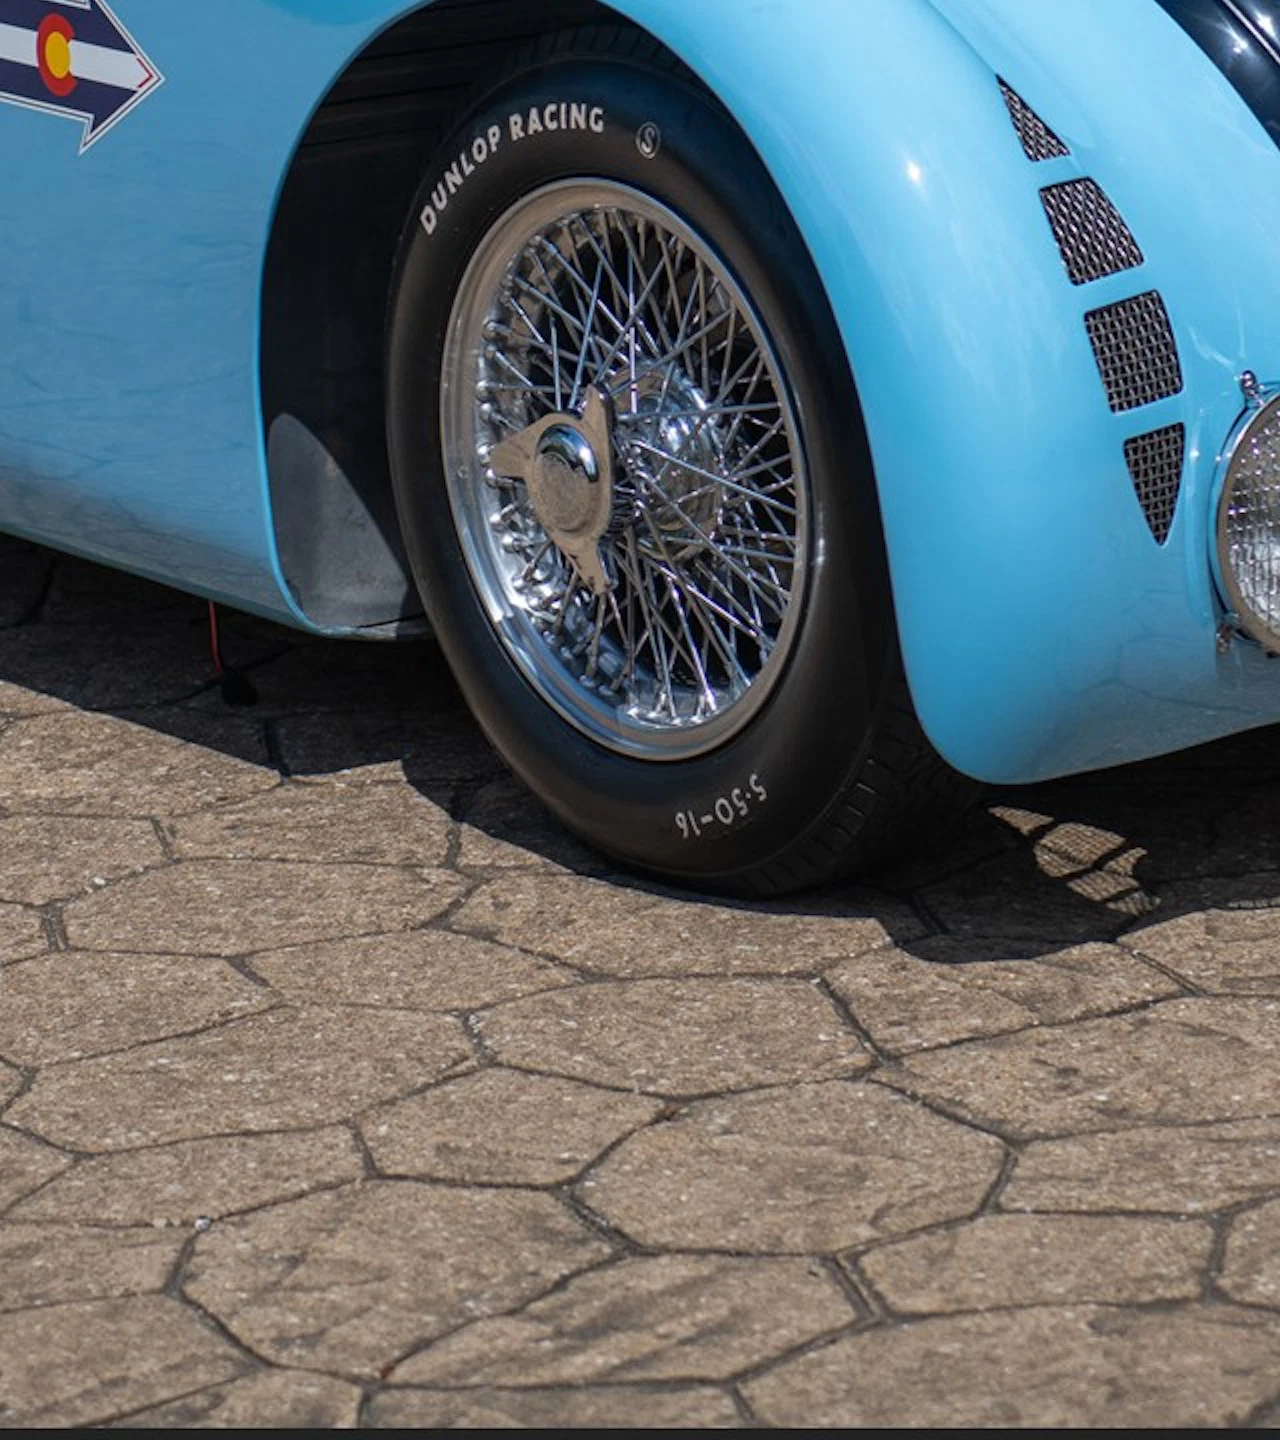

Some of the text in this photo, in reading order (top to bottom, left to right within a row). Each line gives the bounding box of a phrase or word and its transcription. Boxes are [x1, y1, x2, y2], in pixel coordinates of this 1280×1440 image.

[419, 102, 606, 236] DUNLOP RACING
[675, 773, 768, 840] 5.50-16
